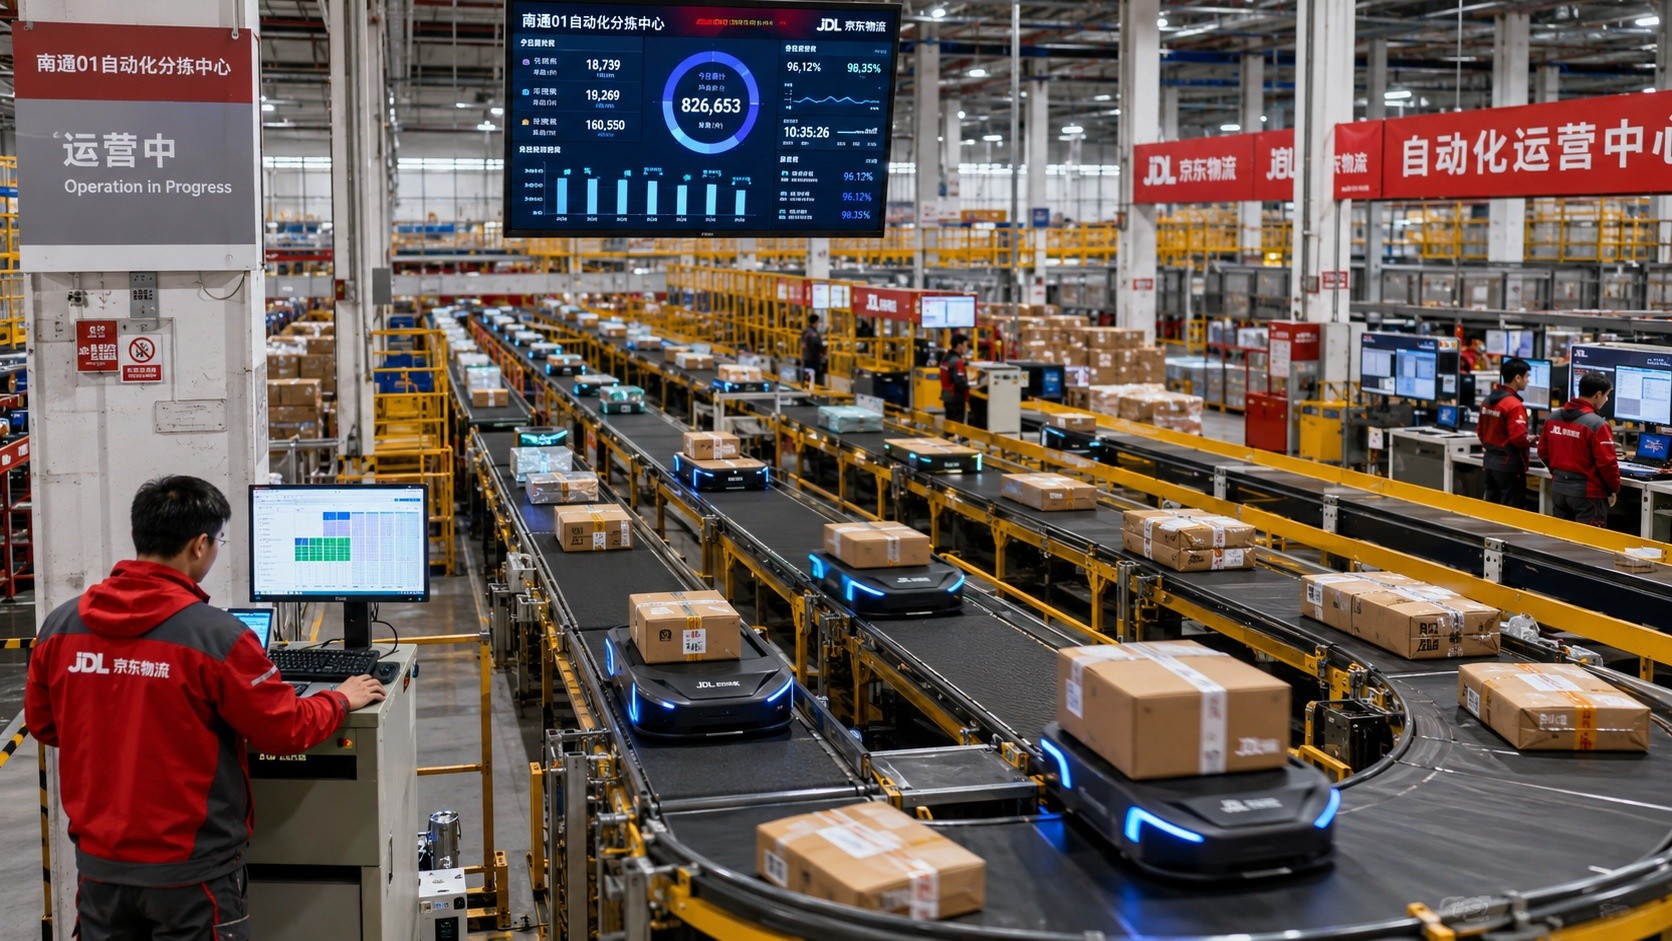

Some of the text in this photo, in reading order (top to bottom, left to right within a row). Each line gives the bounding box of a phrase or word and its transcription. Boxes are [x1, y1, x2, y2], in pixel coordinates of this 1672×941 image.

[522, 13, 665, 31] 南通01自动化分拣中心
[816, 18, 887, 33] JDL 京东物流
[36, 53, 231, 76] 南通01自动化分拣中心
[586, 59, 621, 71] 18,739
[681, 97, 741, 115] 826,653
[784, 126, 830, 138] 10:35:26
[62, 132, 176, 169] 运营中
[843, 171, 874, 182] 96.12%
[1143, 155, 1237, 186] JDL 京东物流
[64, 179, 232, 196] Operation in Progress
[67, 652, 170, 678] JDL 京东物流
